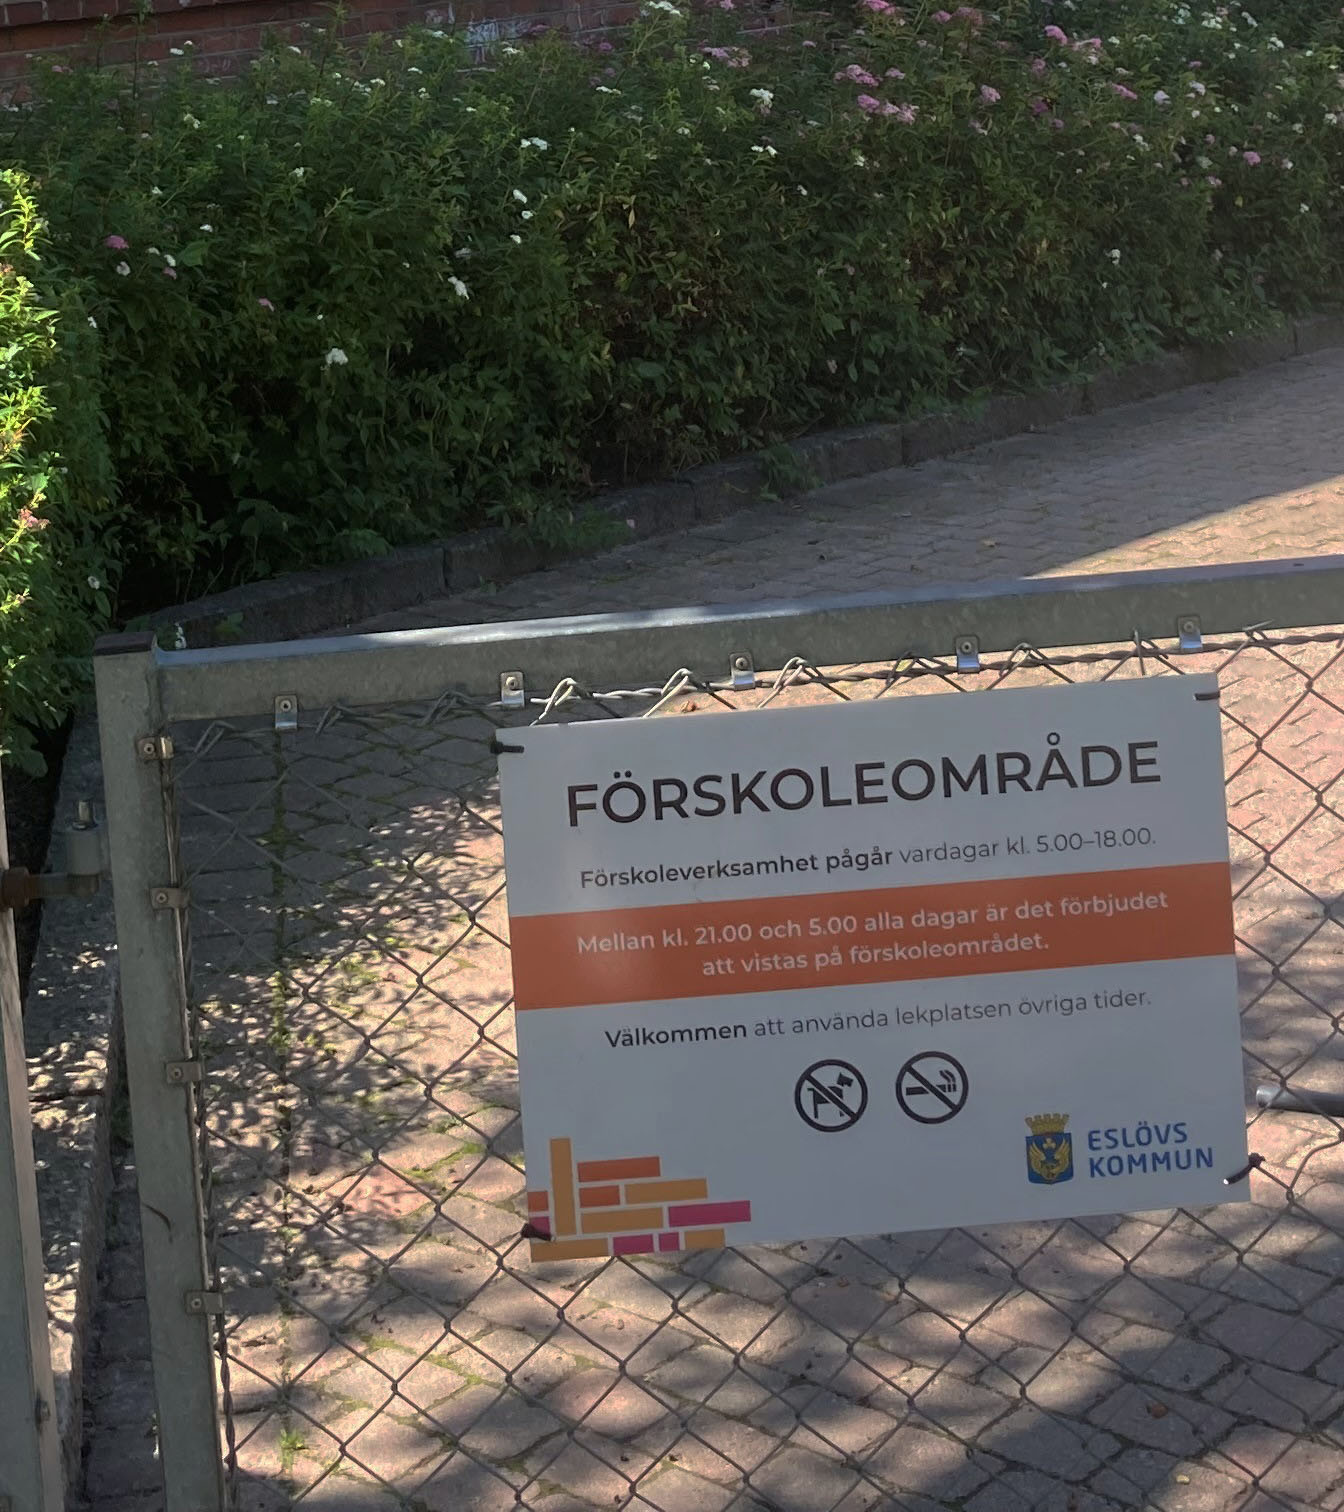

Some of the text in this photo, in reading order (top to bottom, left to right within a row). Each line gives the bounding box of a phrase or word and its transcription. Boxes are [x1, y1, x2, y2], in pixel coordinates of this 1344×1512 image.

[566, 732, 1162, 827] FÖRSKOLEOMRÅDE
[580, 853, 818, 888] Förskoleverksamhet
[826, 846, 892, 874] pågår
[899, 841, 999, 863] vardagar
[1006, 836, 1030, 855] kl.
[577, 891, 1169, 953] Mellan kl. 21.00 och 5.00 alla dagar är det förbjudet
[702, 932, 1049, 976] att vistas på förskoleområdet.
[605, 989, 1152, 1048] Välkommen att använda lekplatsen övriga tider.
[1088, 1121, 1188, 1151] ESLÖVS
[1089, 1147, 1213, 1178] KOMMUN
